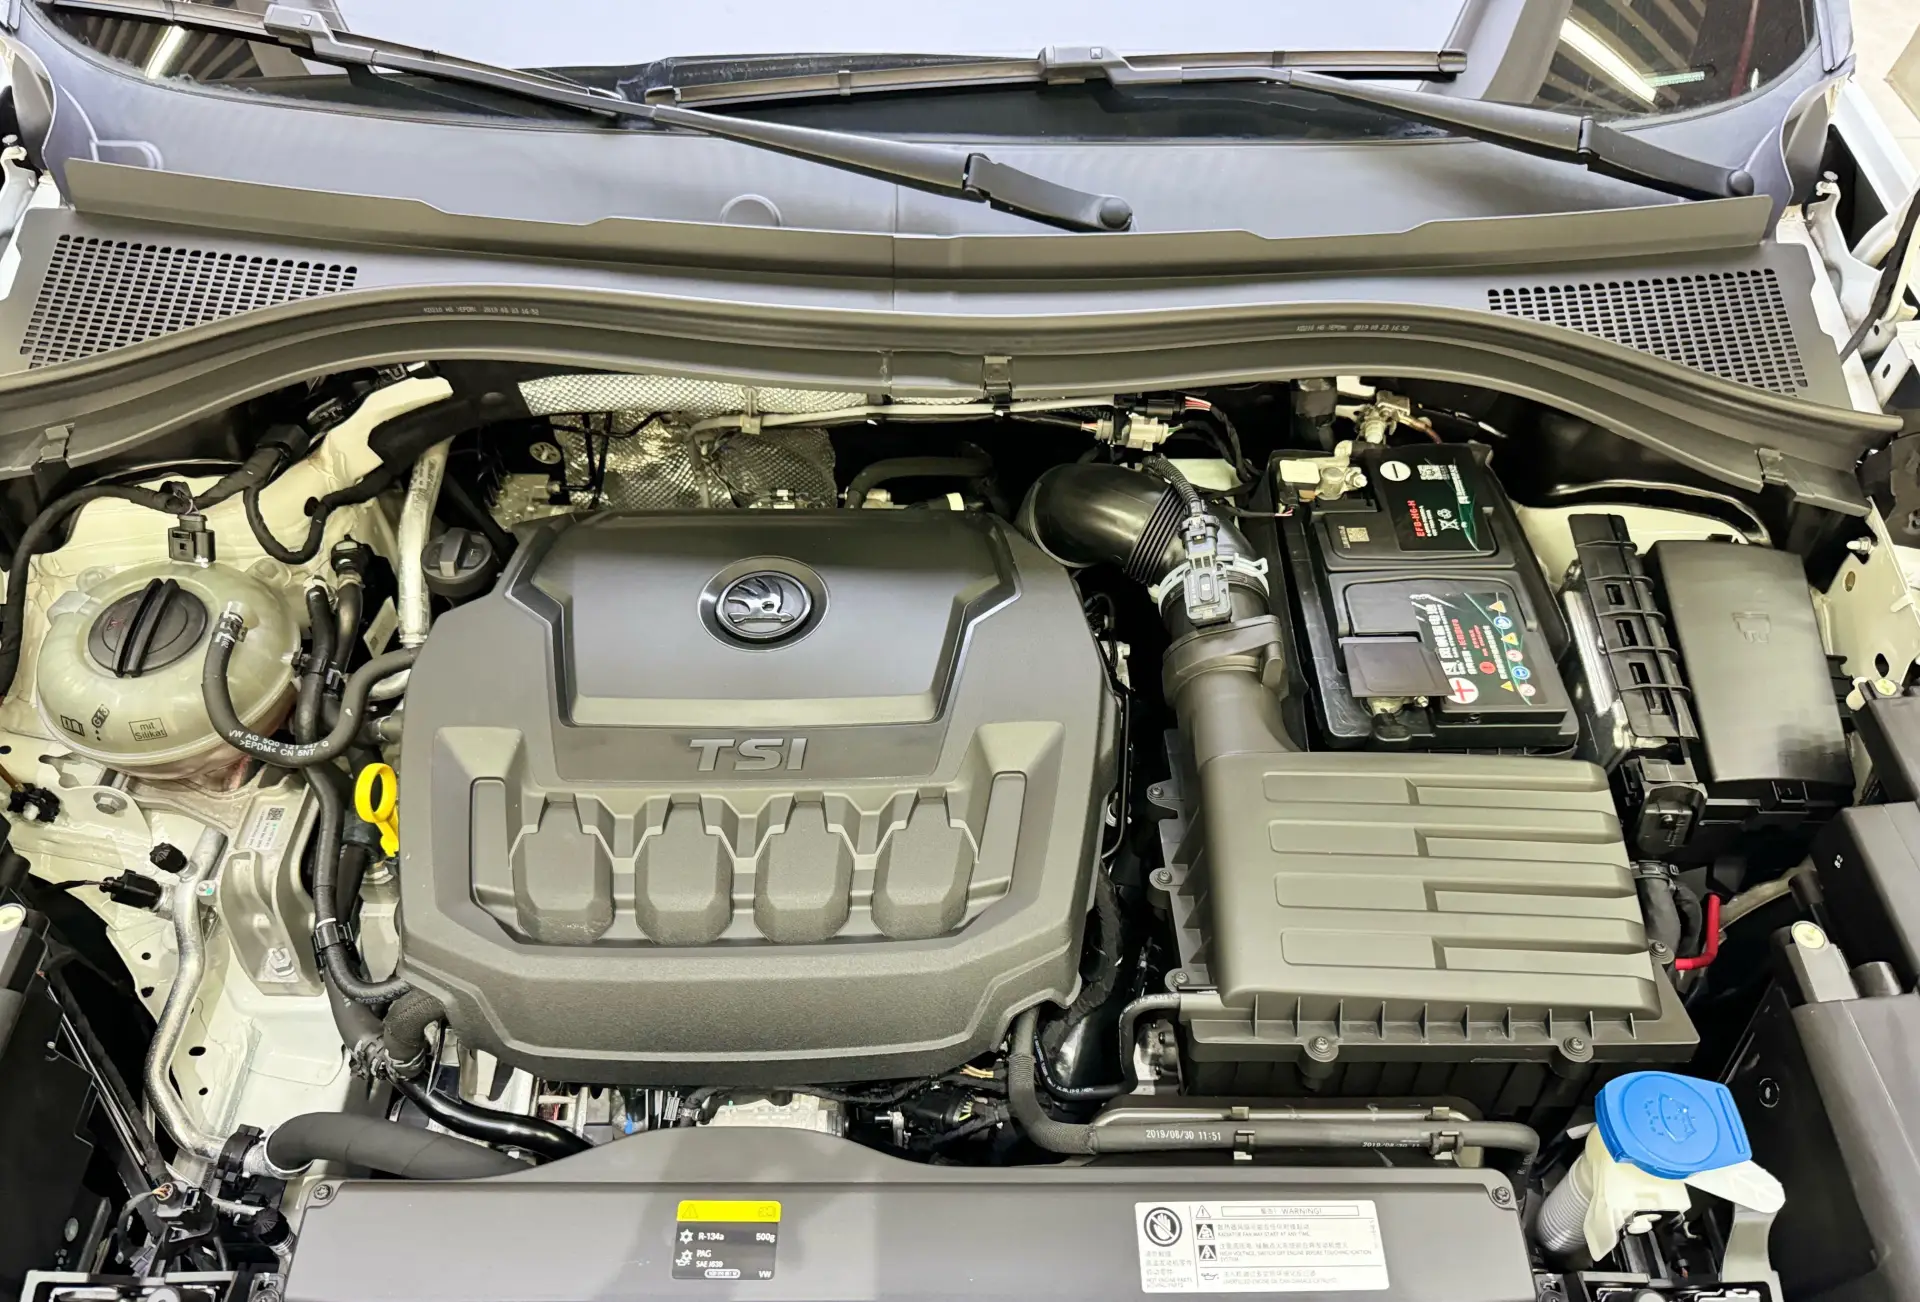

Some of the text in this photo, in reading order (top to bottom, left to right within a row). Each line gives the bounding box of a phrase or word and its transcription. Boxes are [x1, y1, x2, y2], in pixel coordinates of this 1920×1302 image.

[93, 706, 110, 726] G13
[139, 721, 156, 730] mit
[134, 729, 165, 740] Silikat
[245, 733, 259, 742] AG
[280, 748, 294, 757] CN
[689, 737, 808, 771] TSI
[1198, 1131, 1221, 1141] 11:51
[1281, 1207, 1322, 1215] WARNING!
[698, 1232, 776, 1243] R-134a 500g
[696, 1249, 712, 1258] PAG
[696, 1260, 708, 1268] SAE
[758, 1270, 772, 1278] VW
